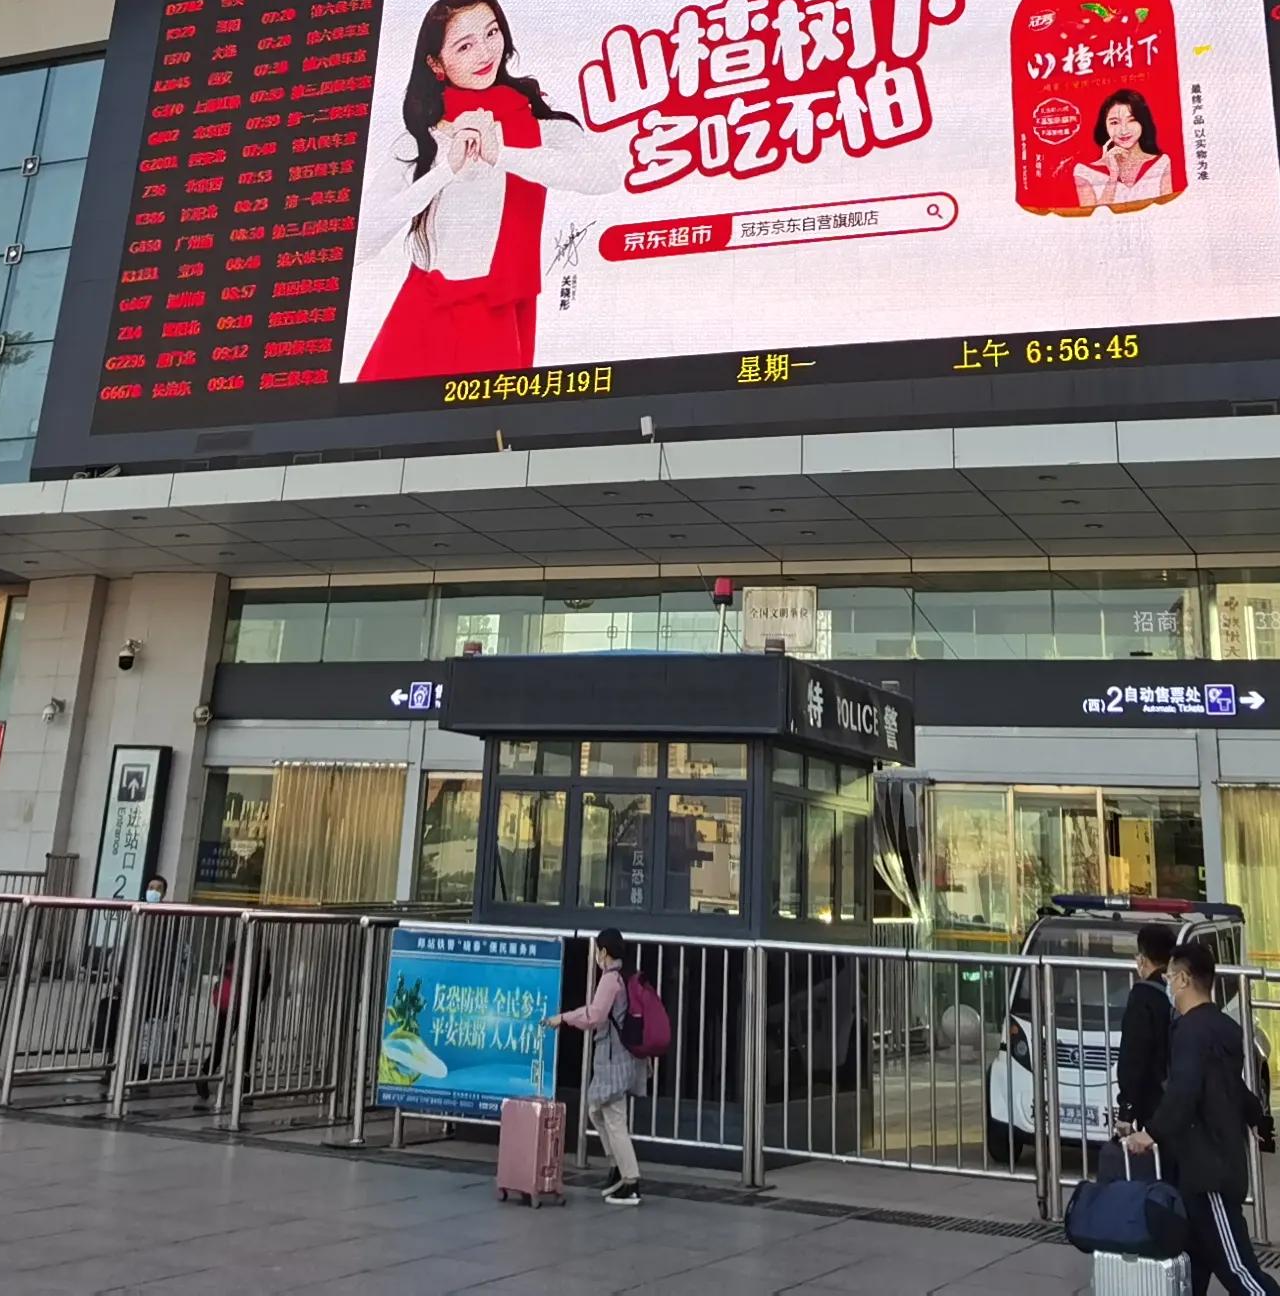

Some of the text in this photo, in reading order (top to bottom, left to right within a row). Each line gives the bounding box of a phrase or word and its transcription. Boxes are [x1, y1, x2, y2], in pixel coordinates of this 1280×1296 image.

[1026, 32, 1160, 81] 山楂树下
[622, 60, 933, 194] 多吃不怕
[622, 222, 713, 254] 京东超市
[740, 209, 880, 239] 冠芳京东自营旗舰店
[443, 335, 1140, 403] 2021年04月19日 星期一 上午 6:56:45
[1132, 609, 1178, 634] 招商
[806, 679, 824, 729] 特
[883, 704, 899, 752] 警
[1106, 685, 1124, 713] 2
[1124, 685, 1202, 704] 自动售票处
[121, 807, 144, 871] 进站口
[112, 874, 128, 900] 2
[432, 982, 549, 1020] 反恐防爆 全民参与
[430, 1014, 487, 1050] 平安铁路
